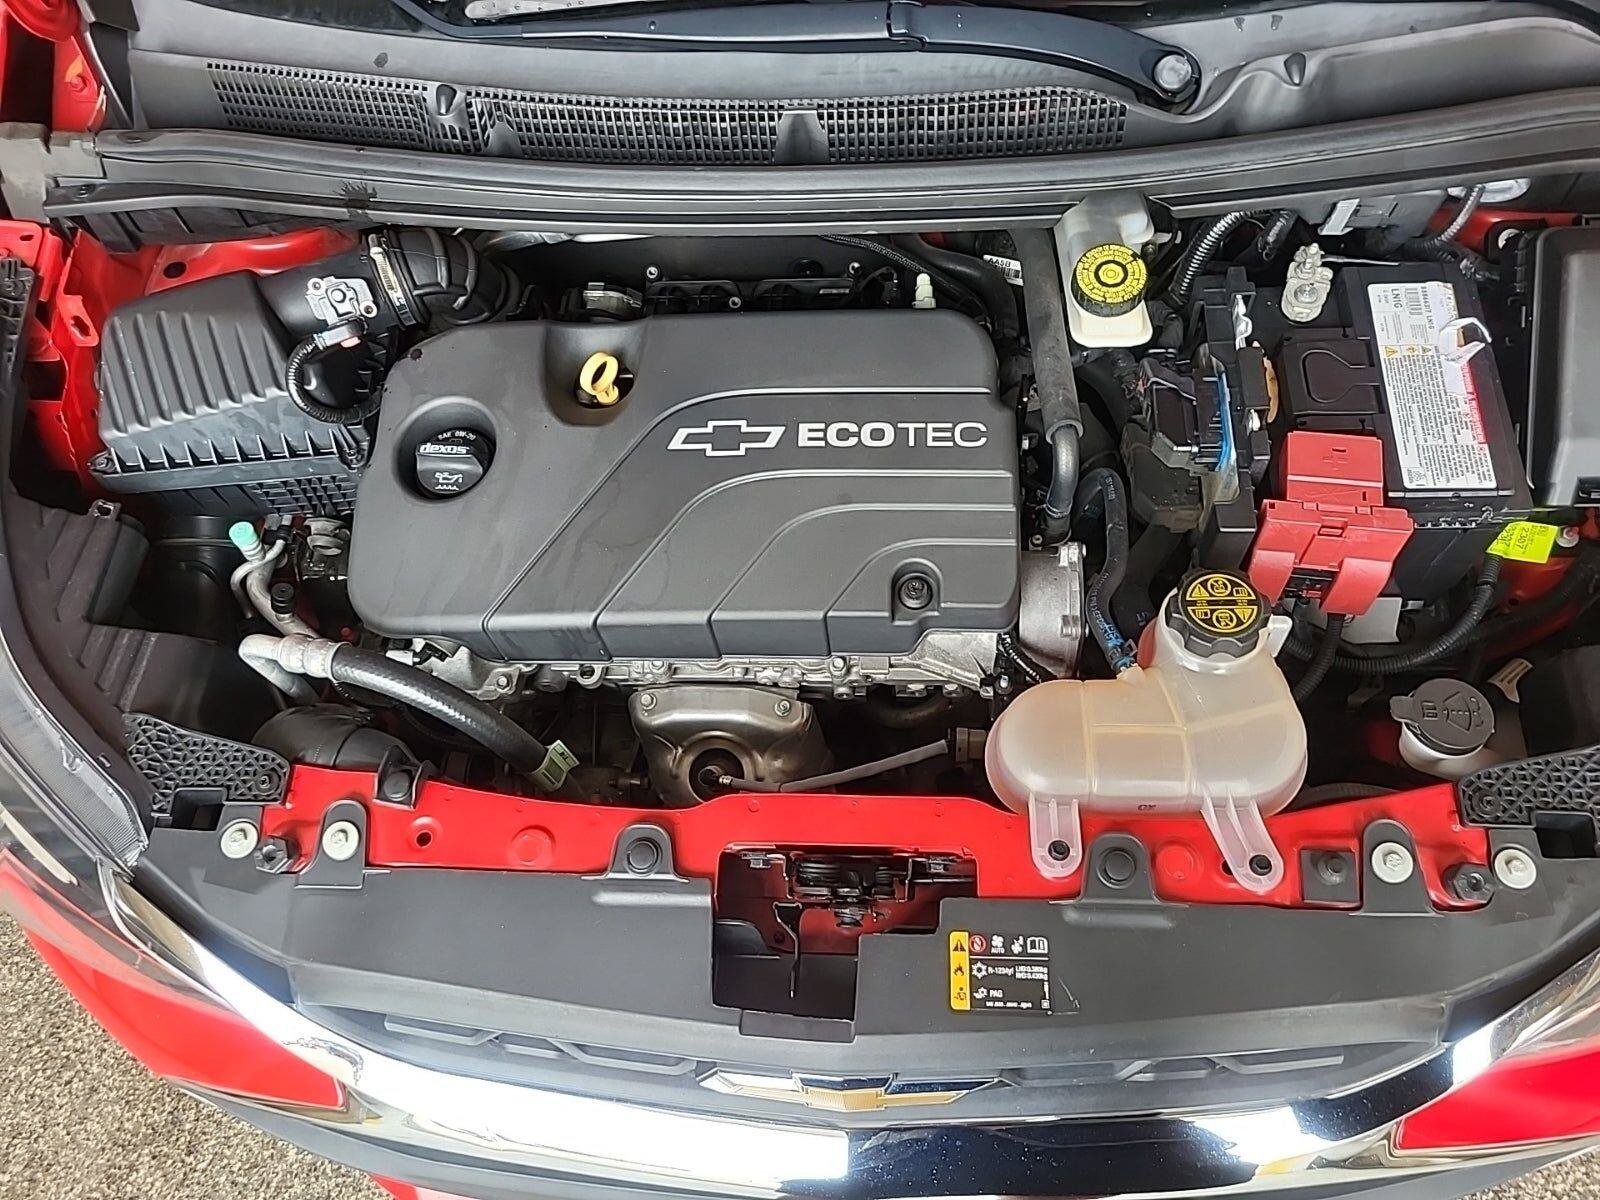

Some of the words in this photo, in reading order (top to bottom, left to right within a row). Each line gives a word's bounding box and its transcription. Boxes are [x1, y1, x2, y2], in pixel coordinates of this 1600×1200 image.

[1390, 288, 1403, 309] LN1G
[797, 422, 987, 447] ECOTEC
[419, 443, 470, 454] dexos
